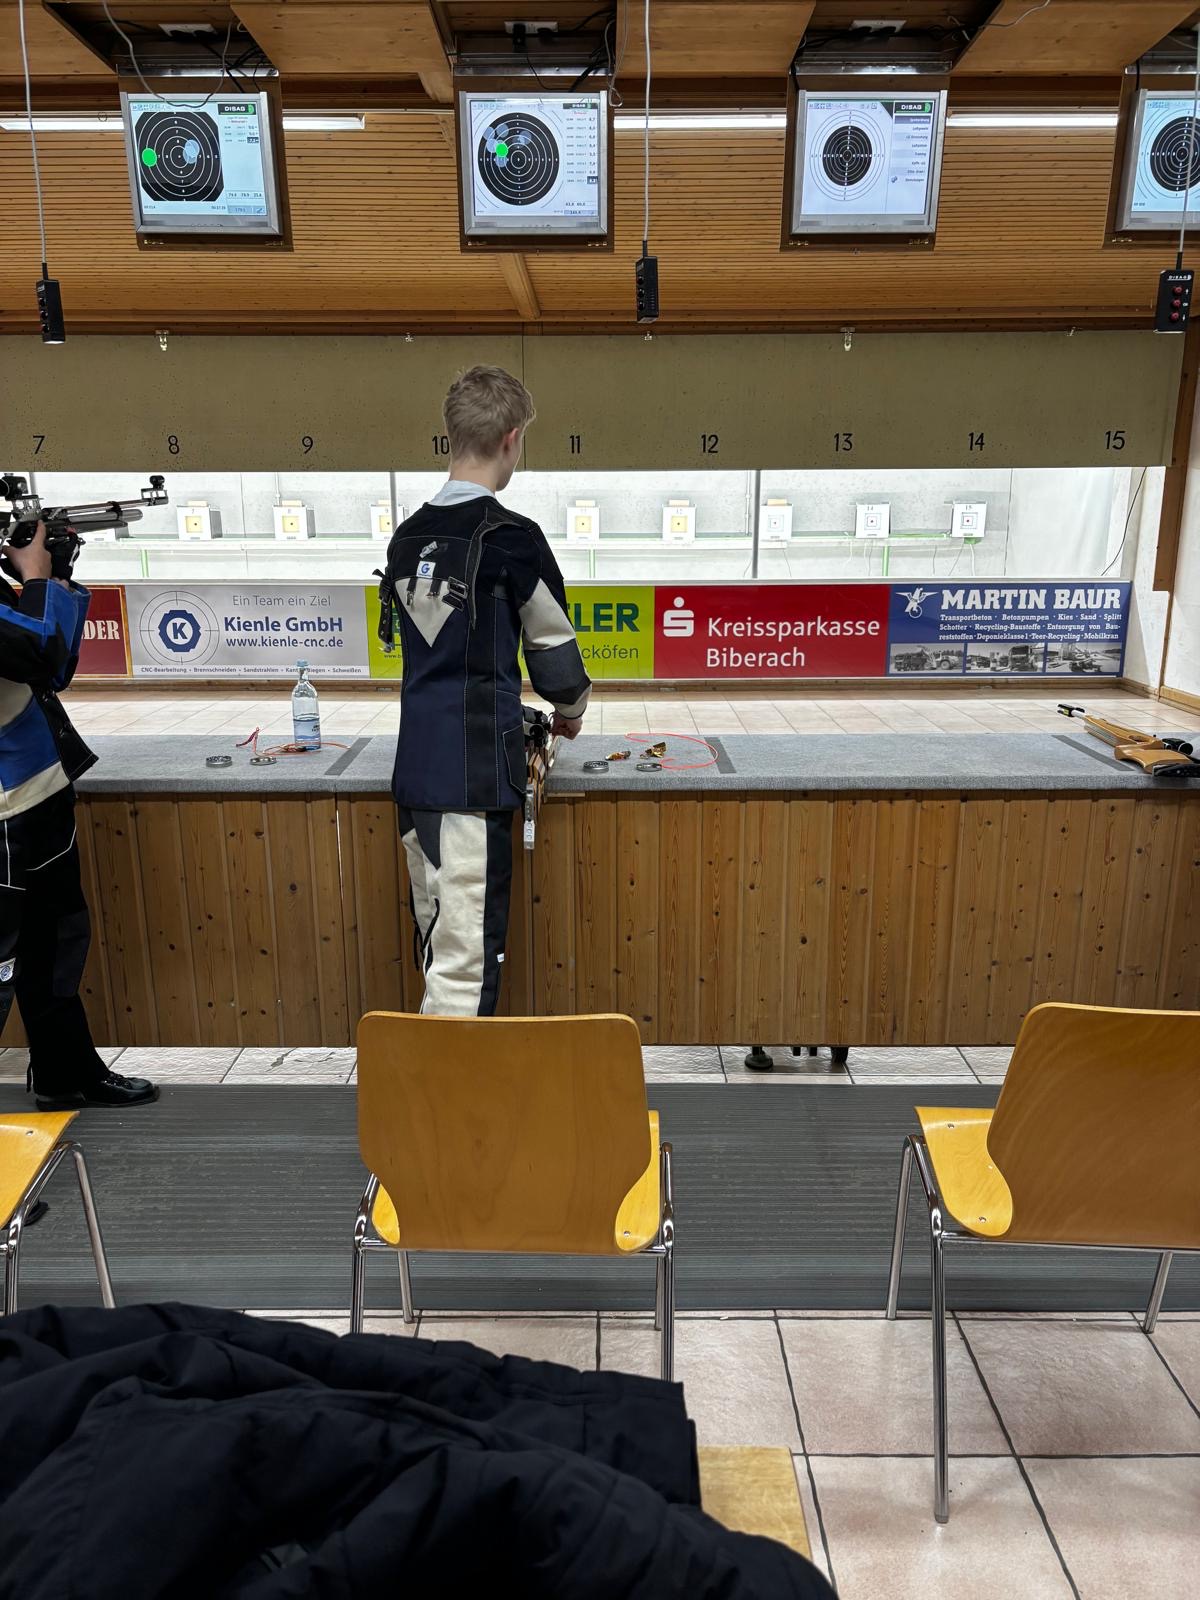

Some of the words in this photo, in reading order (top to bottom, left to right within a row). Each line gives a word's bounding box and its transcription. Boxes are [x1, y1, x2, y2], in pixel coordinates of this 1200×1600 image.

[33, 435, 45, 454] 7
[168, 435, 180, 454] 8
[302, 436, 314, 454] 9
[432, 436, 450, 455] 10
[569, 435, 580, 454] 11
[701, 434, 719, 454] 12
[834, 433, 853, 452] 13
[968, 432, 985, 451] 14
[1105, 430, 1126, 450] 15
[233, 595, 250, 606] Ein
[253, 595, 284, 606] Team
[288, 595, 306, 606] ein
[310, 596, 331, 606] Ziel
[941, 589, 1047, 610] MARTIN
[1053, 588, 1121, 609] BAUR
[224, 616, 281, 632] Kienle
[286, 616, 343, 632] GmbH
[568, 603, 640, 632] LER
[940, 614, 992, 622] Transportbeton
[1002, 614, 1050, 622] Betonpumpen
[1104, 614, 1122, 622] Splitt
[81, 620, 120, 640] DER
[172, 622, 188, 640] K
[708, 616, 880, 642] Kreissparkasse
[974, 624, 1041, 632] Recycling-Baustoffe
[226, 636, 344, 648] www.kienle-cnc.de
[582, 645, 639, 659] cköfen
[706, 647, 805, 668] Biberach
